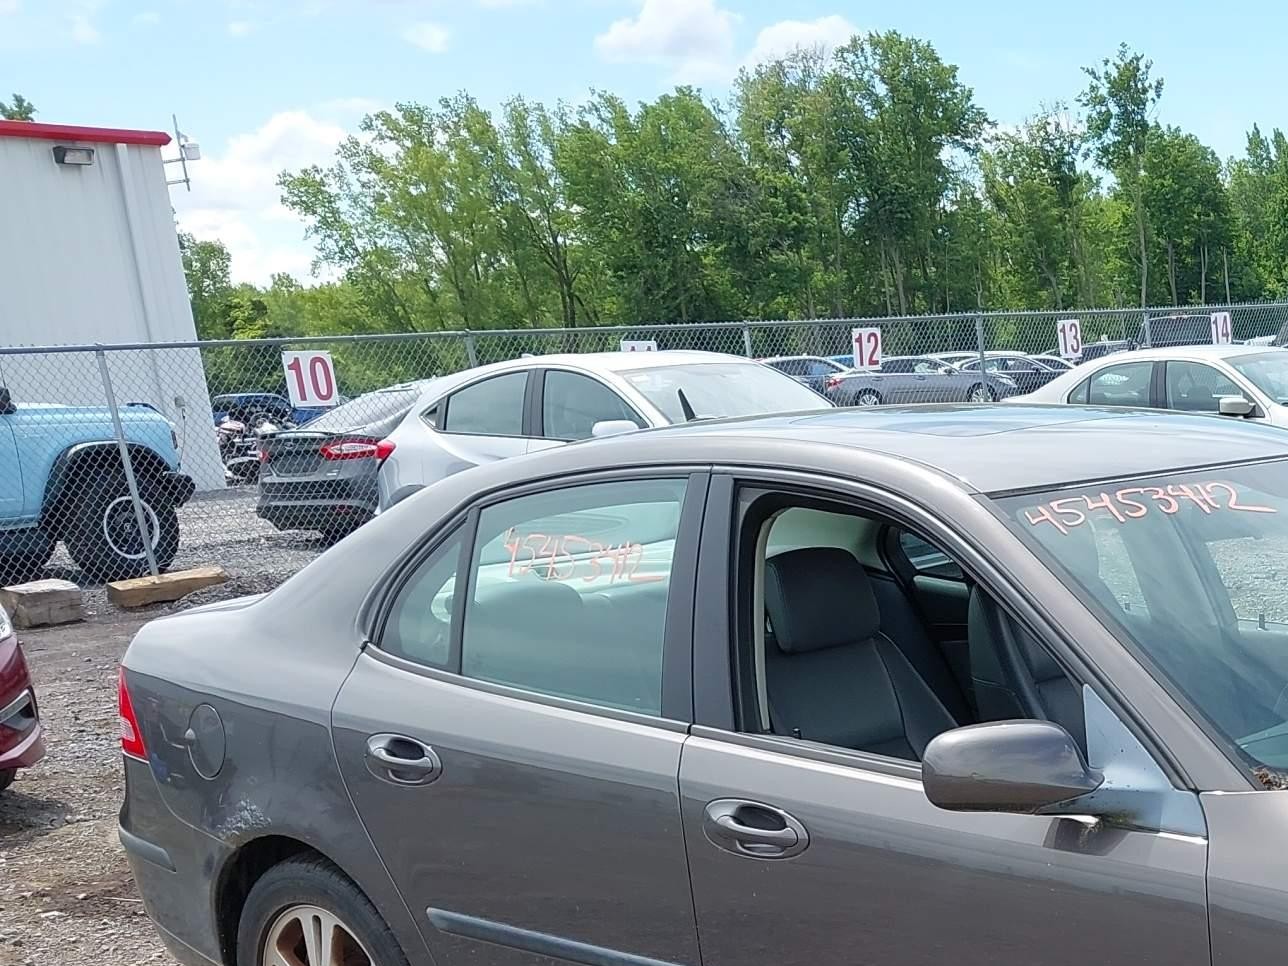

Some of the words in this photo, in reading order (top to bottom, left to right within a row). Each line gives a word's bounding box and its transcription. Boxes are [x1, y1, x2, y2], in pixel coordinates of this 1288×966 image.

[1060, 323, 1080, 354] 13
[1212, 315, 1230, 344] 14
[855, 332, 880, 366] 12
[287, 356, 333, 401] 10
[1024, 480, 1278, 535] 45453412
